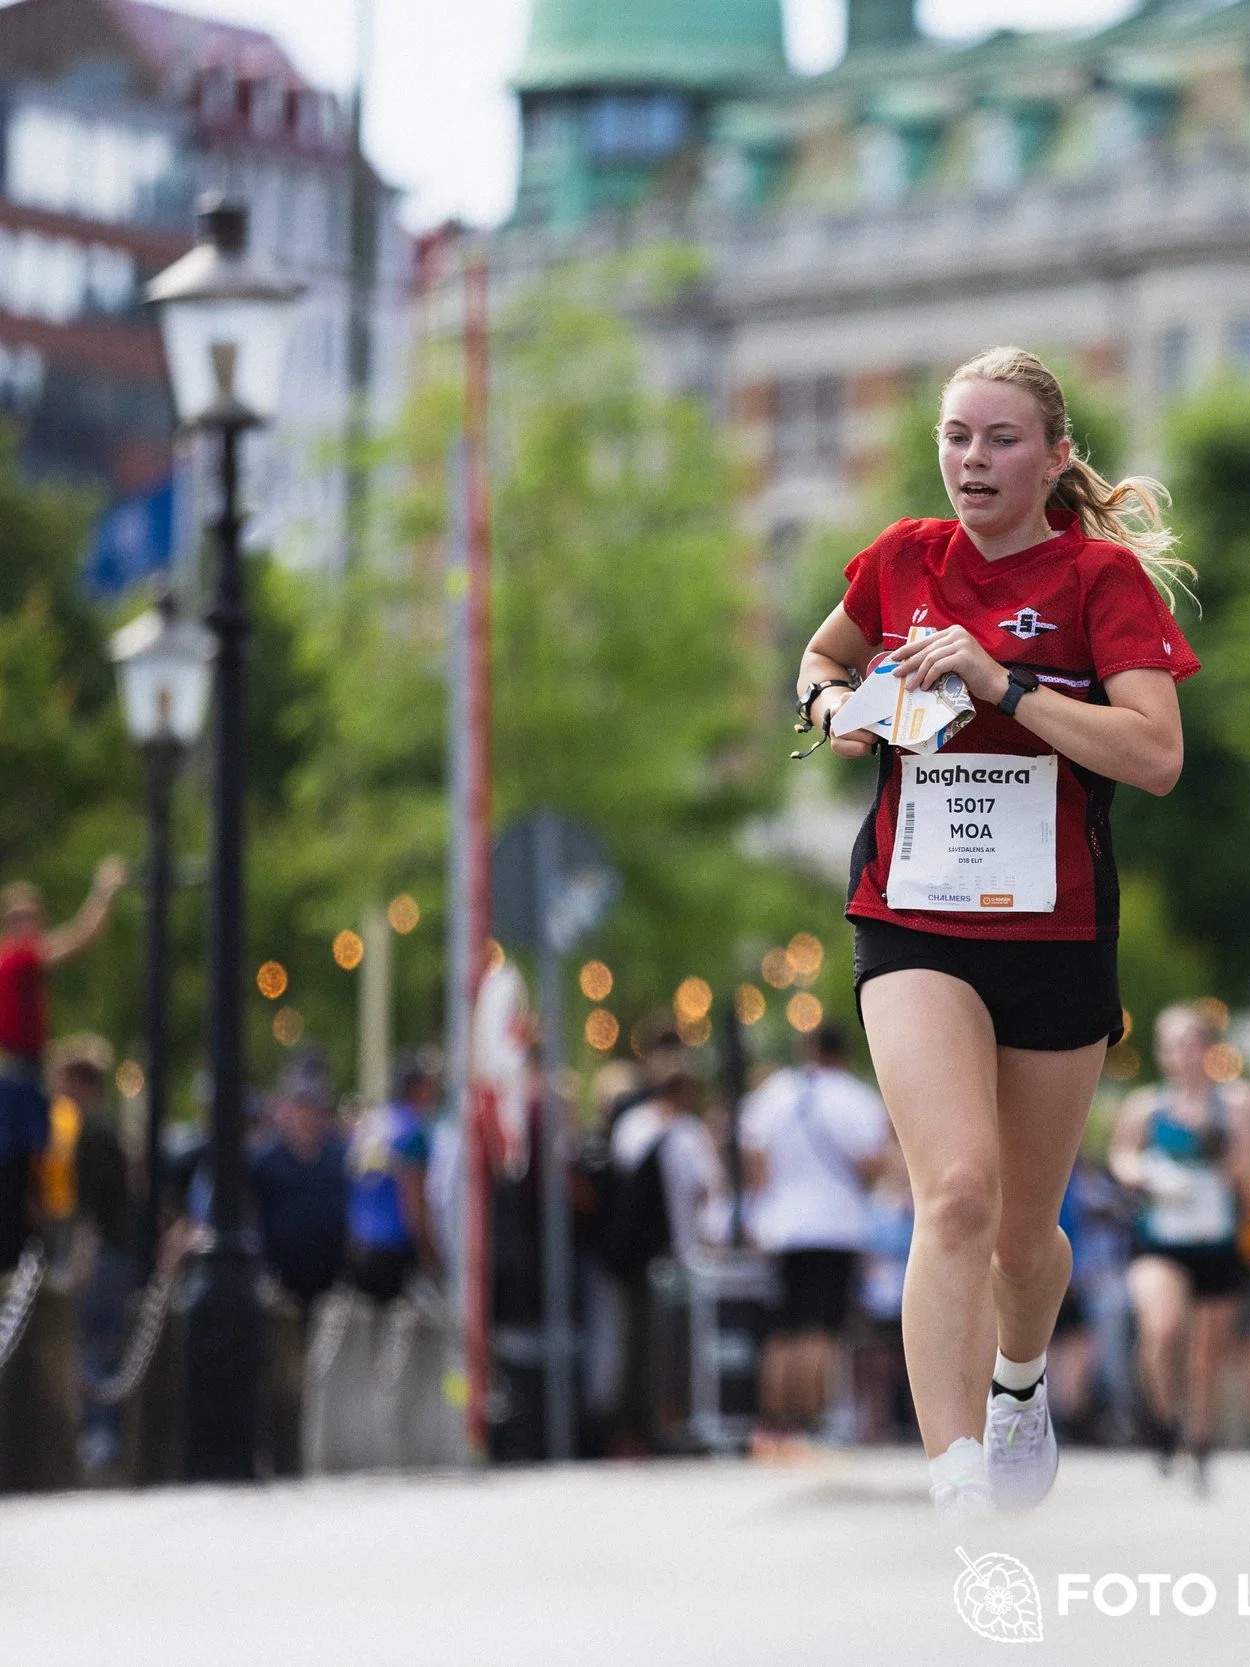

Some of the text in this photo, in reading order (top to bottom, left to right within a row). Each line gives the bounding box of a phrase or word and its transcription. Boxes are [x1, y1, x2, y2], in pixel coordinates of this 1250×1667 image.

[916, 765, 1030, 786] bagheera
[946, 798, 996, 814] 15017
[950, 823, 993, 839] MOA
[928, 894, 971, 902] CHALMERS
